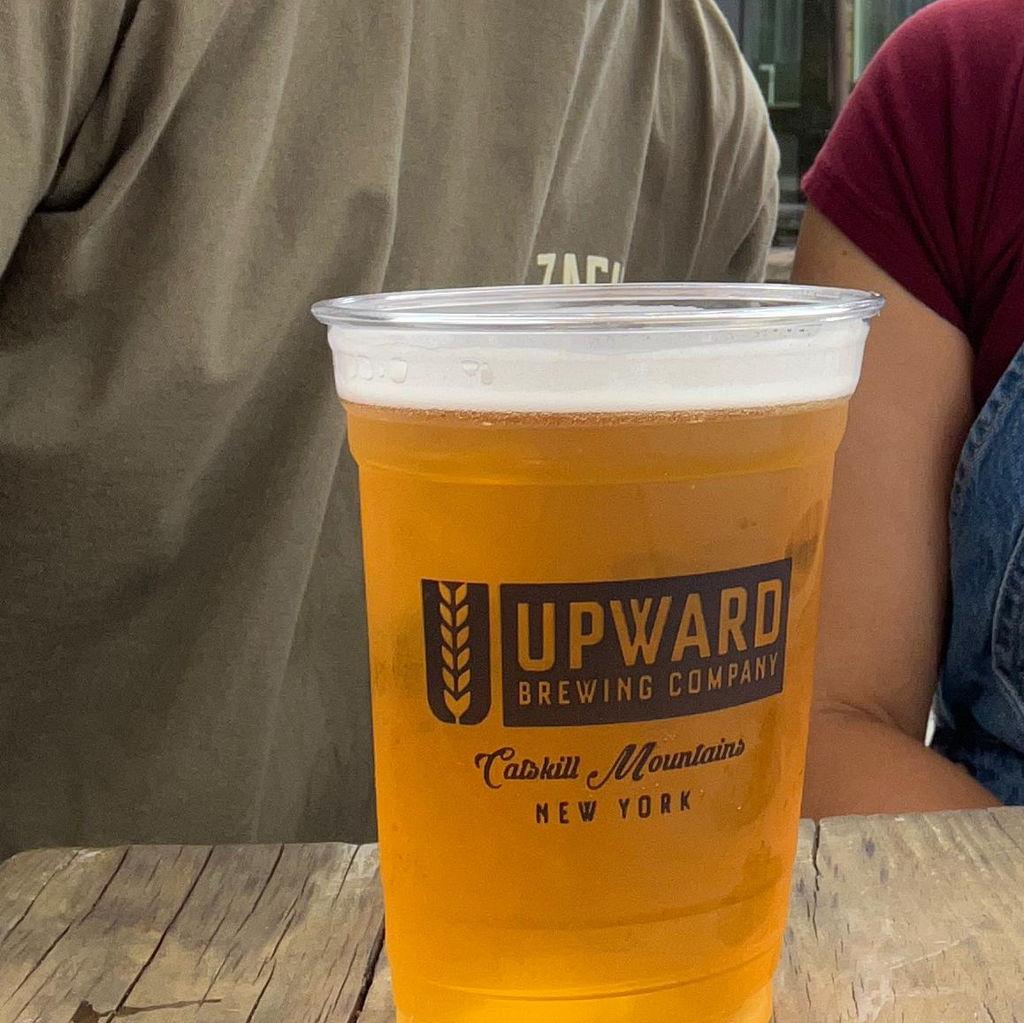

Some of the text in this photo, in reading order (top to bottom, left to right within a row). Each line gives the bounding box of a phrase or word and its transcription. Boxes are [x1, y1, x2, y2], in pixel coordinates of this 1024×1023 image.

[517, 579, 783, 671] UPWARD
[518, 652, 779, 706] BREWING COMPANY
[474, 737, 746, 790] Catskill Mountains
[536, 790, 691, 824] NEW YORK
